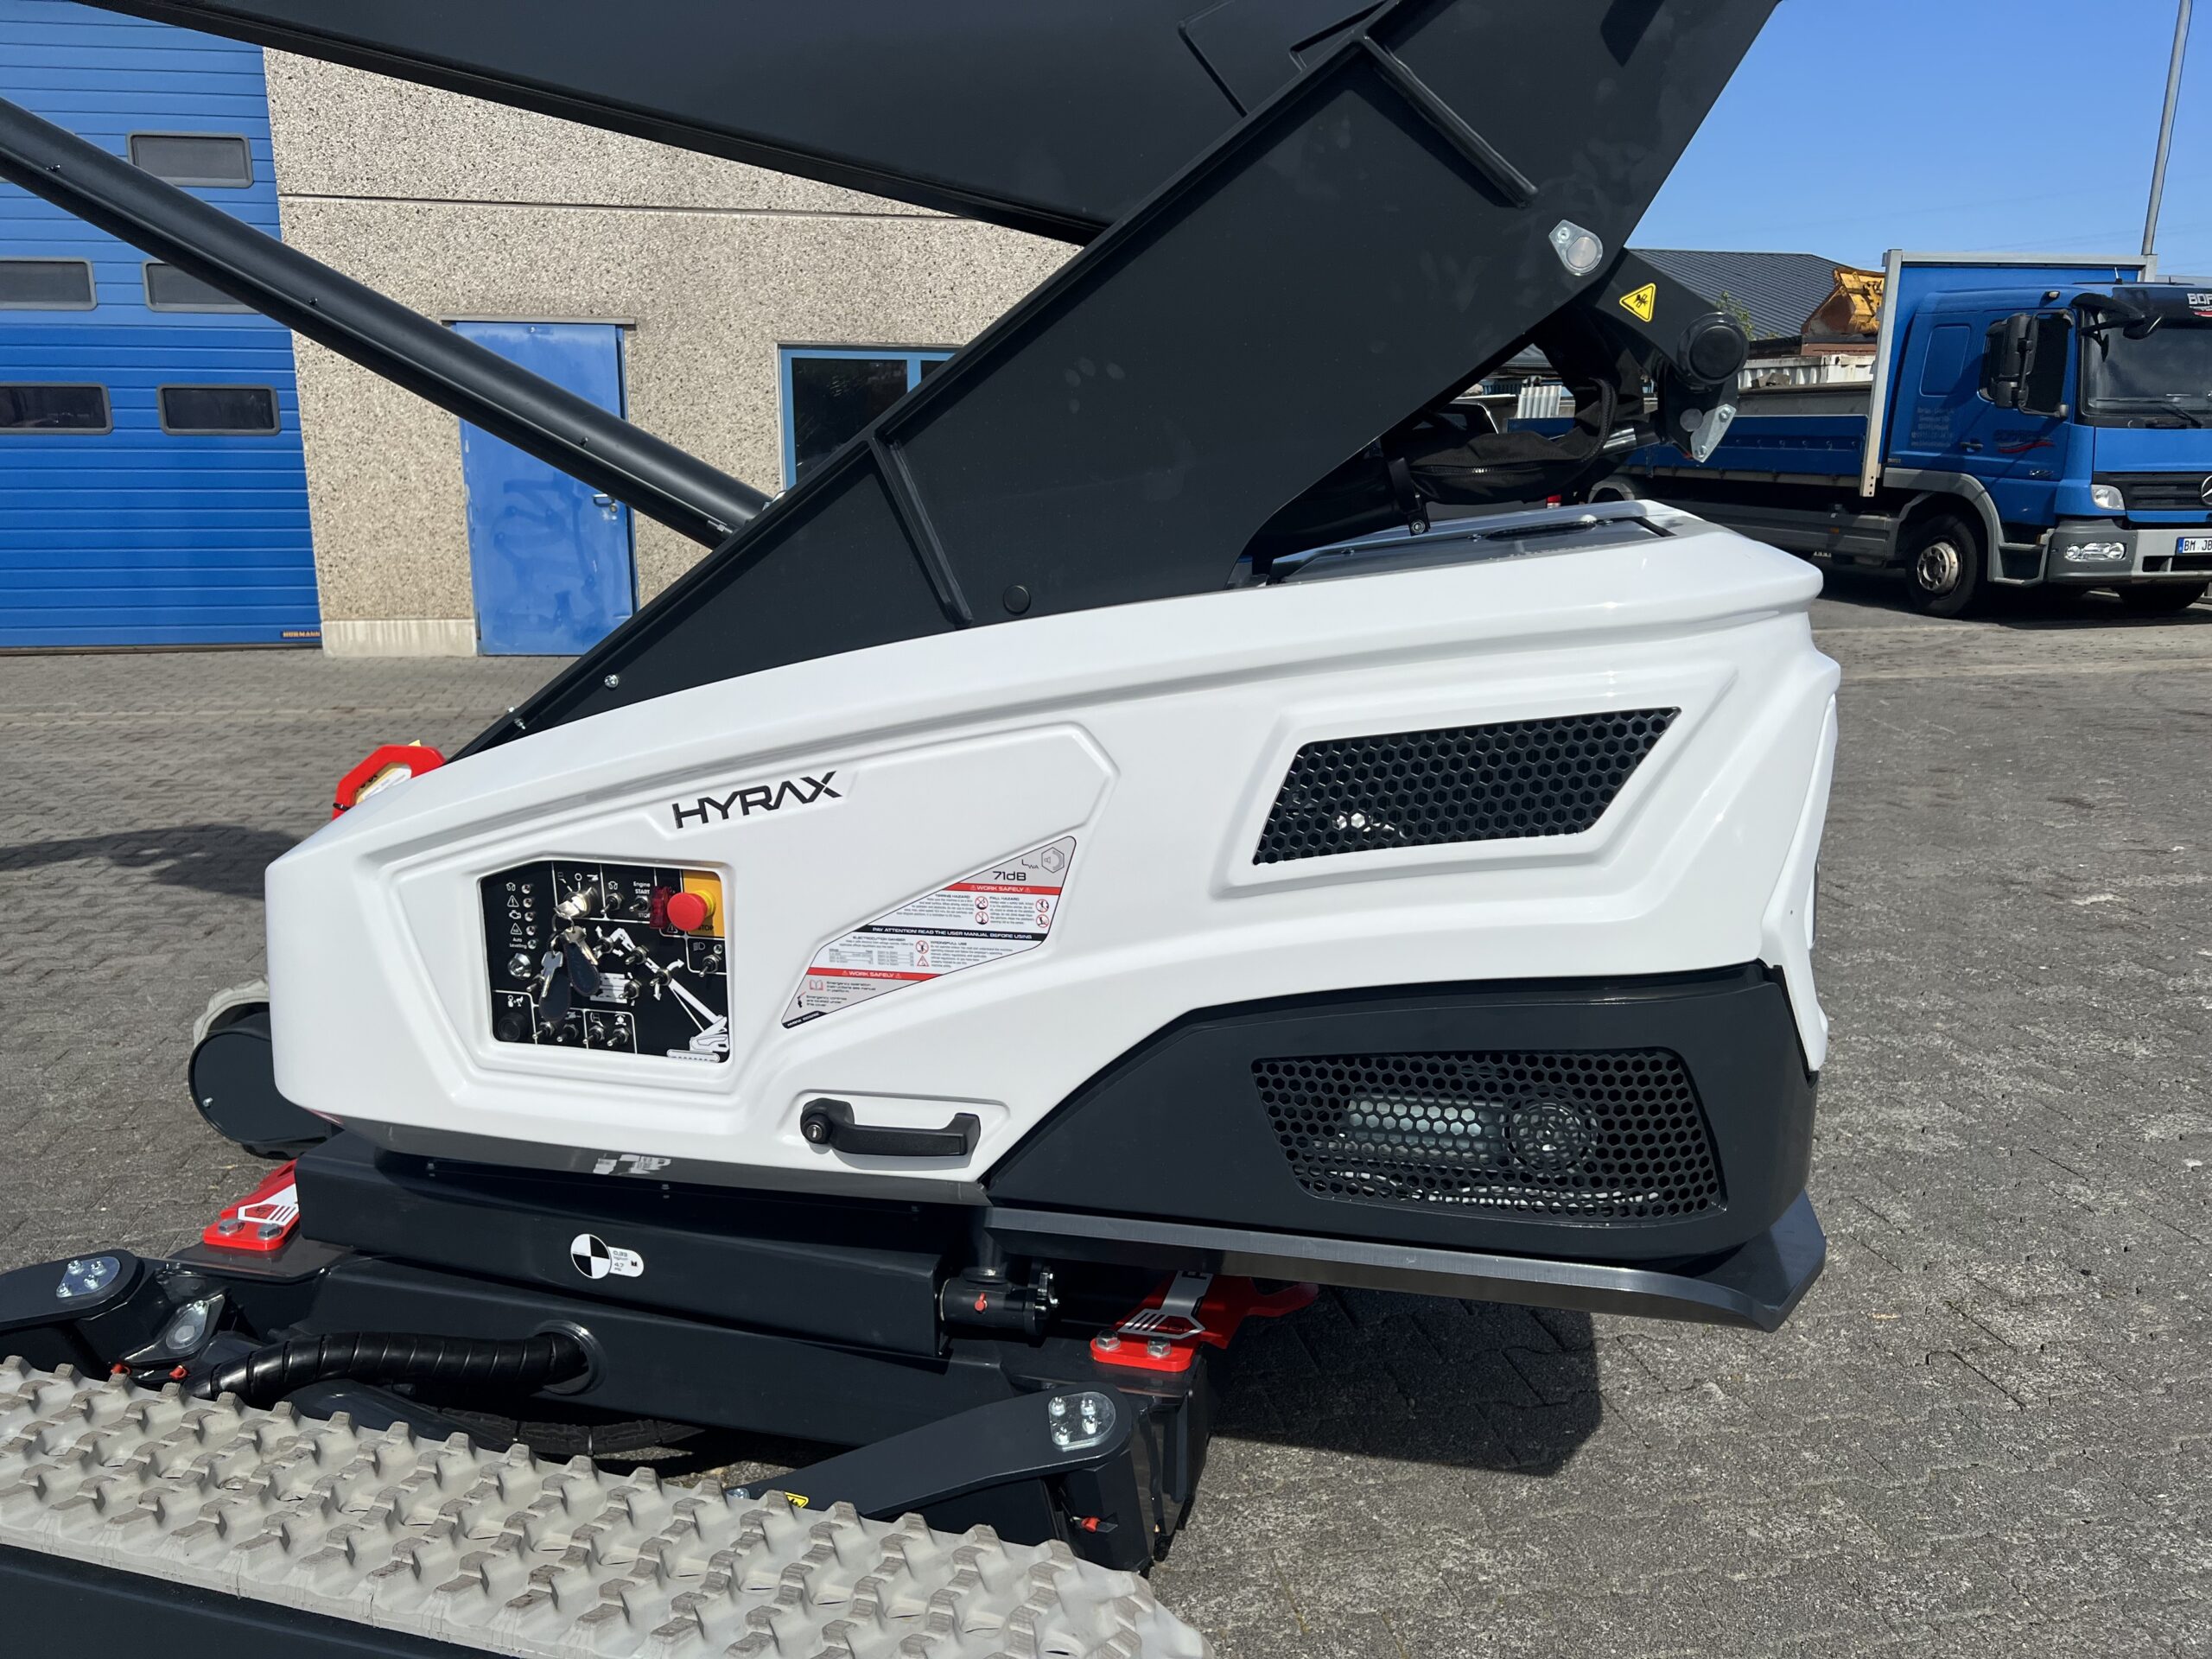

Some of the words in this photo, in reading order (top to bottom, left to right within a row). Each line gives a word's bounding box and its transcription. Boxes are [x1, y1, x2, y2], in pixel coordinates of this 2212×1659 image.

[2183, 540, 2196, 551] BM
[672, 771, 843, 829] HYRAX
[993, 871, 1027, 881] 71dB
